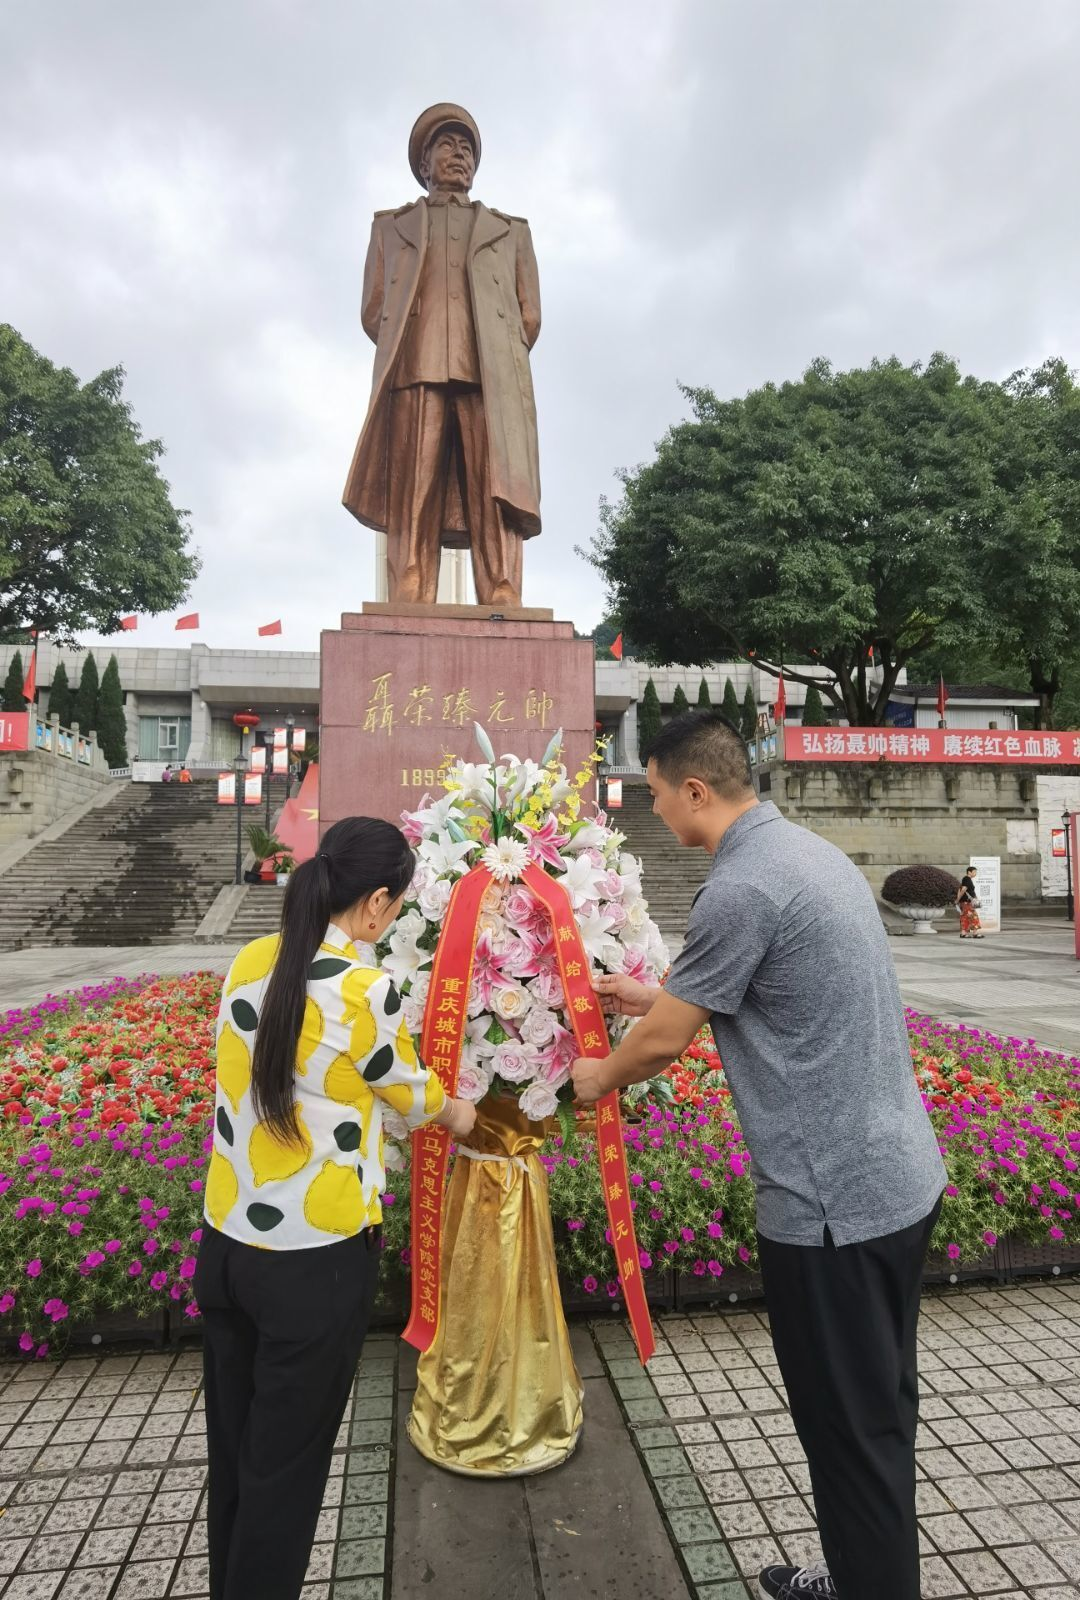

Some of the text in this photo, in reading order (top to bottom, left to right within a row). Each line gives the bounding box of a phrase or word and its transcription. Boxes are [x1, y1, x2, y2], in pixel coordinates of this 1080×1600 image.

[400, 769, 446, 786] 1899
[802, 733, 930, 756] 弘扬聂帅精神
[943, 735, 1061, 758] 赓续红色血脉
[419, 977, 464, 1323] 重庆城市职院马克思主义学院党支部
[558, 926, 634, 1280] 献给敬爱聂荣臻元帅
